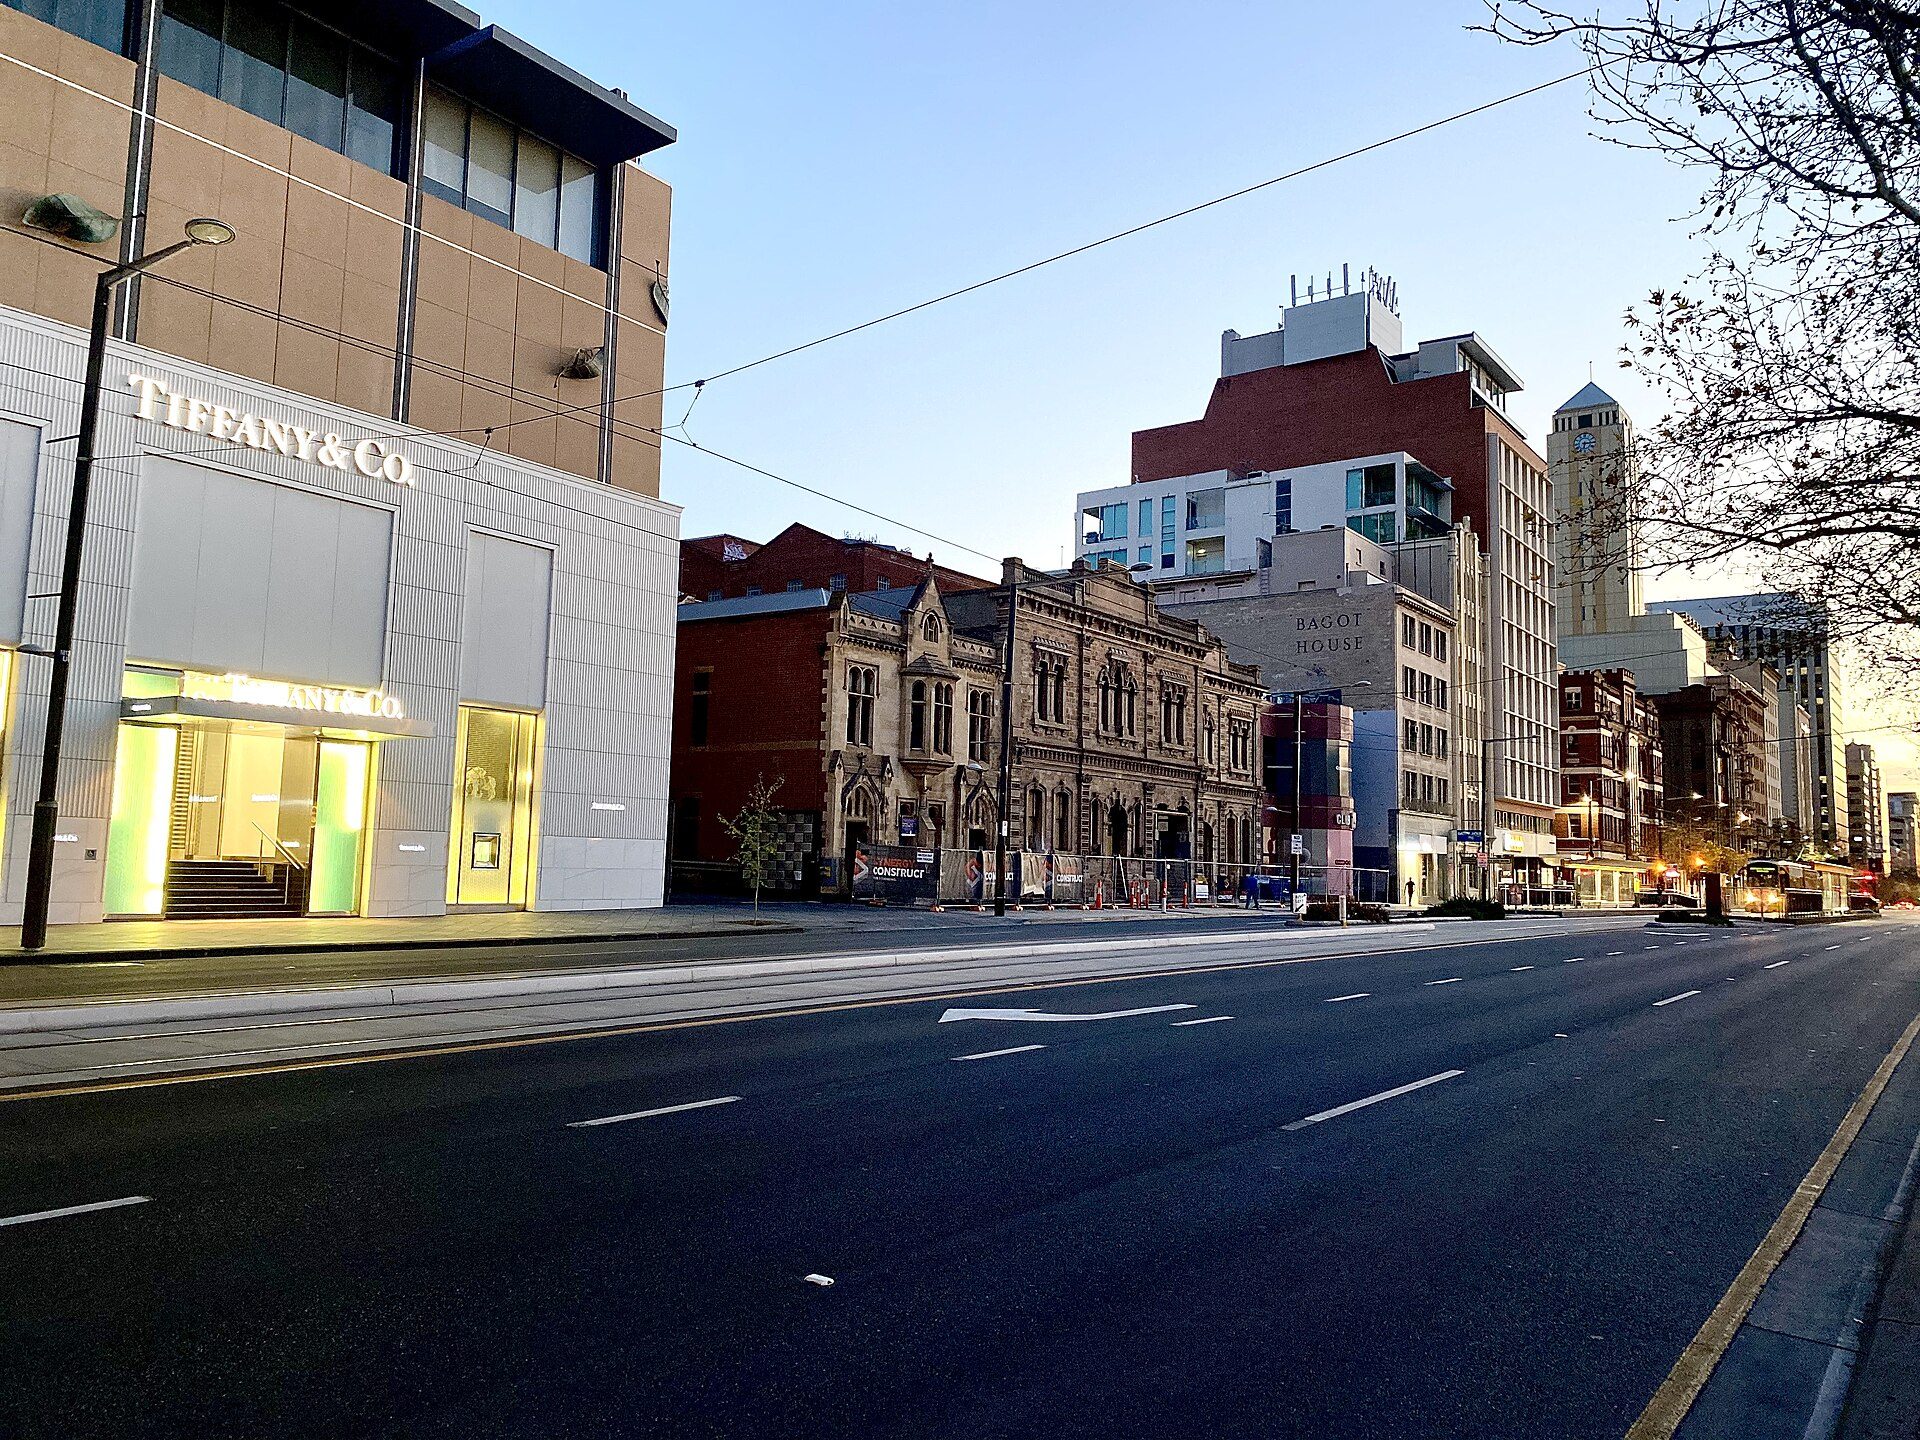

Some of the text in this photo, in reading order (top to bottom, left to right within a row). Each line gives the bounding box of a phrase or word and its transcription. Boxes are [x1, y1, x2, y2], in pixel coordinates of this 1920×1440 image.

[1296, 613, 1362, 630] BAGOT
[1296, 637, 1363, 653] HOUSE
[873, 866, 925, 878] CONSTRUCT
[1056, 874, 1083, 883] CONSTRUCT
